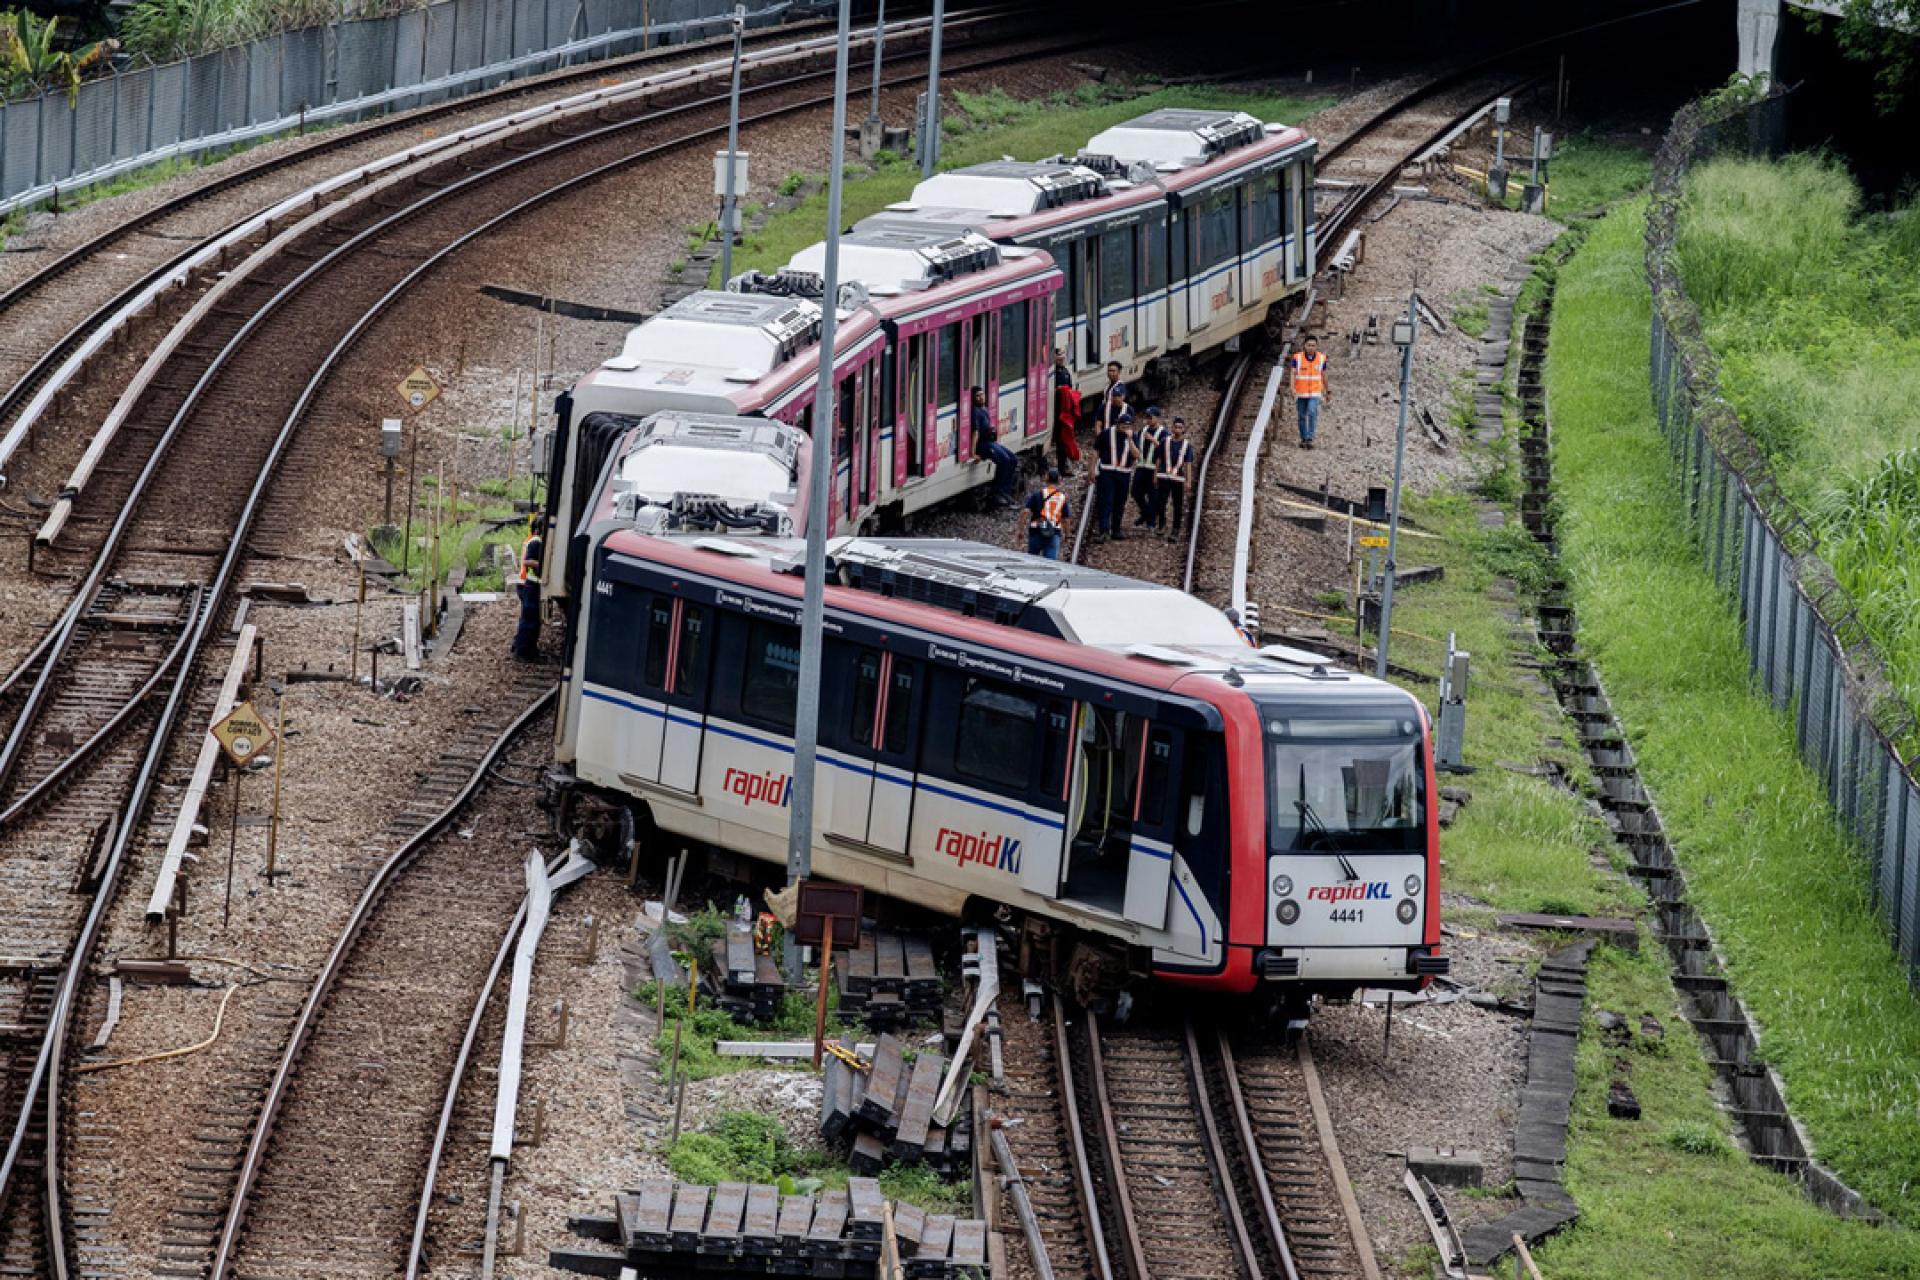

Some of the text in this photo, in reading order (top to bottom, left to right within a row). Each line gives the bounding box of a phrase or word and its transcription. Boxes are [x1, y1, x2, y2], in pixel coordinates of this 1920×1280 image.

[723, 767, 794, 807] rapidK
[1307, 881, 1392, 904] rapidKL
[1329, 908, 1363, 923] 4441
